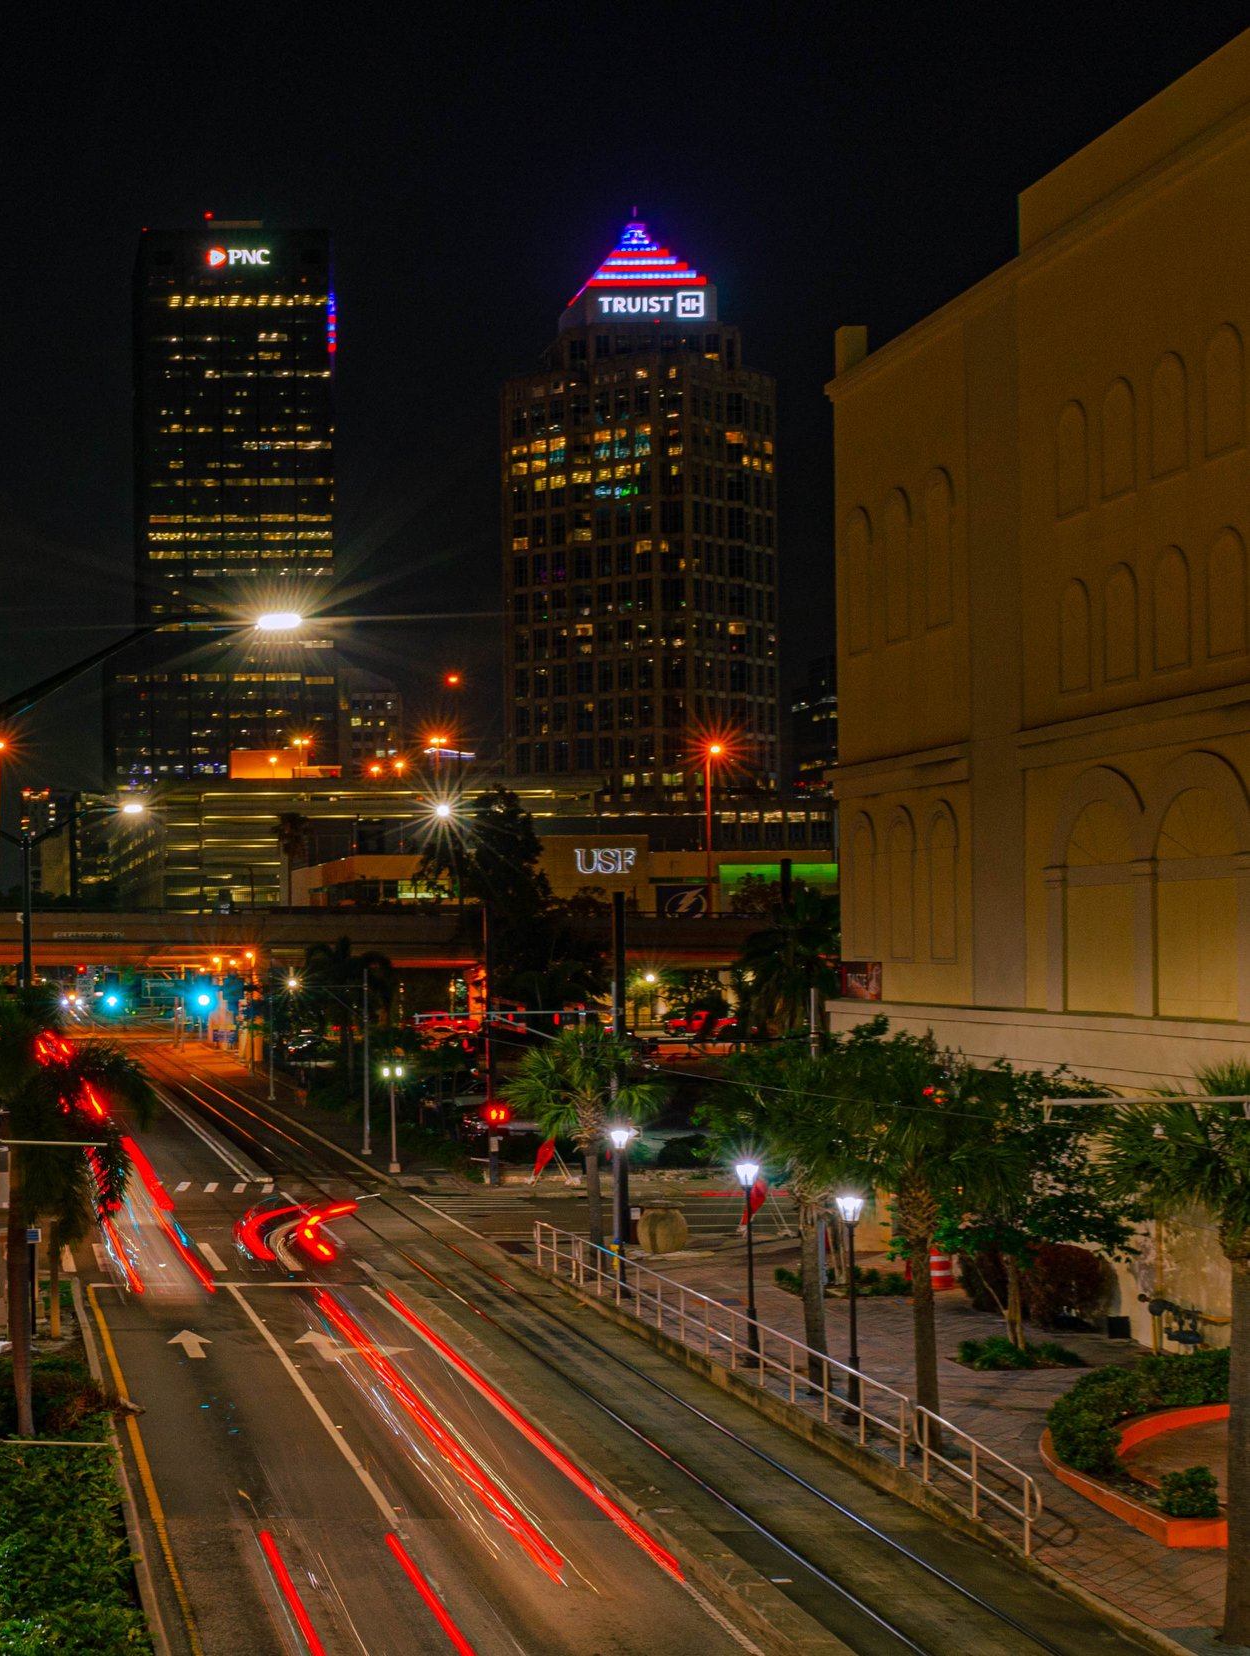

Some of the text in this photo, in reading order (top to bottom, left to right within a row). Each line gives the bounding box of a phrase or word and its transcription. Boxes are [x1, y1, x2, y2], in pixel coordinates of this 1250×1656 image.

[227, 249, 270, 265] PNC
[598, 296, 674, 313] TRUIST
[573, 847, 638, 874] USF
